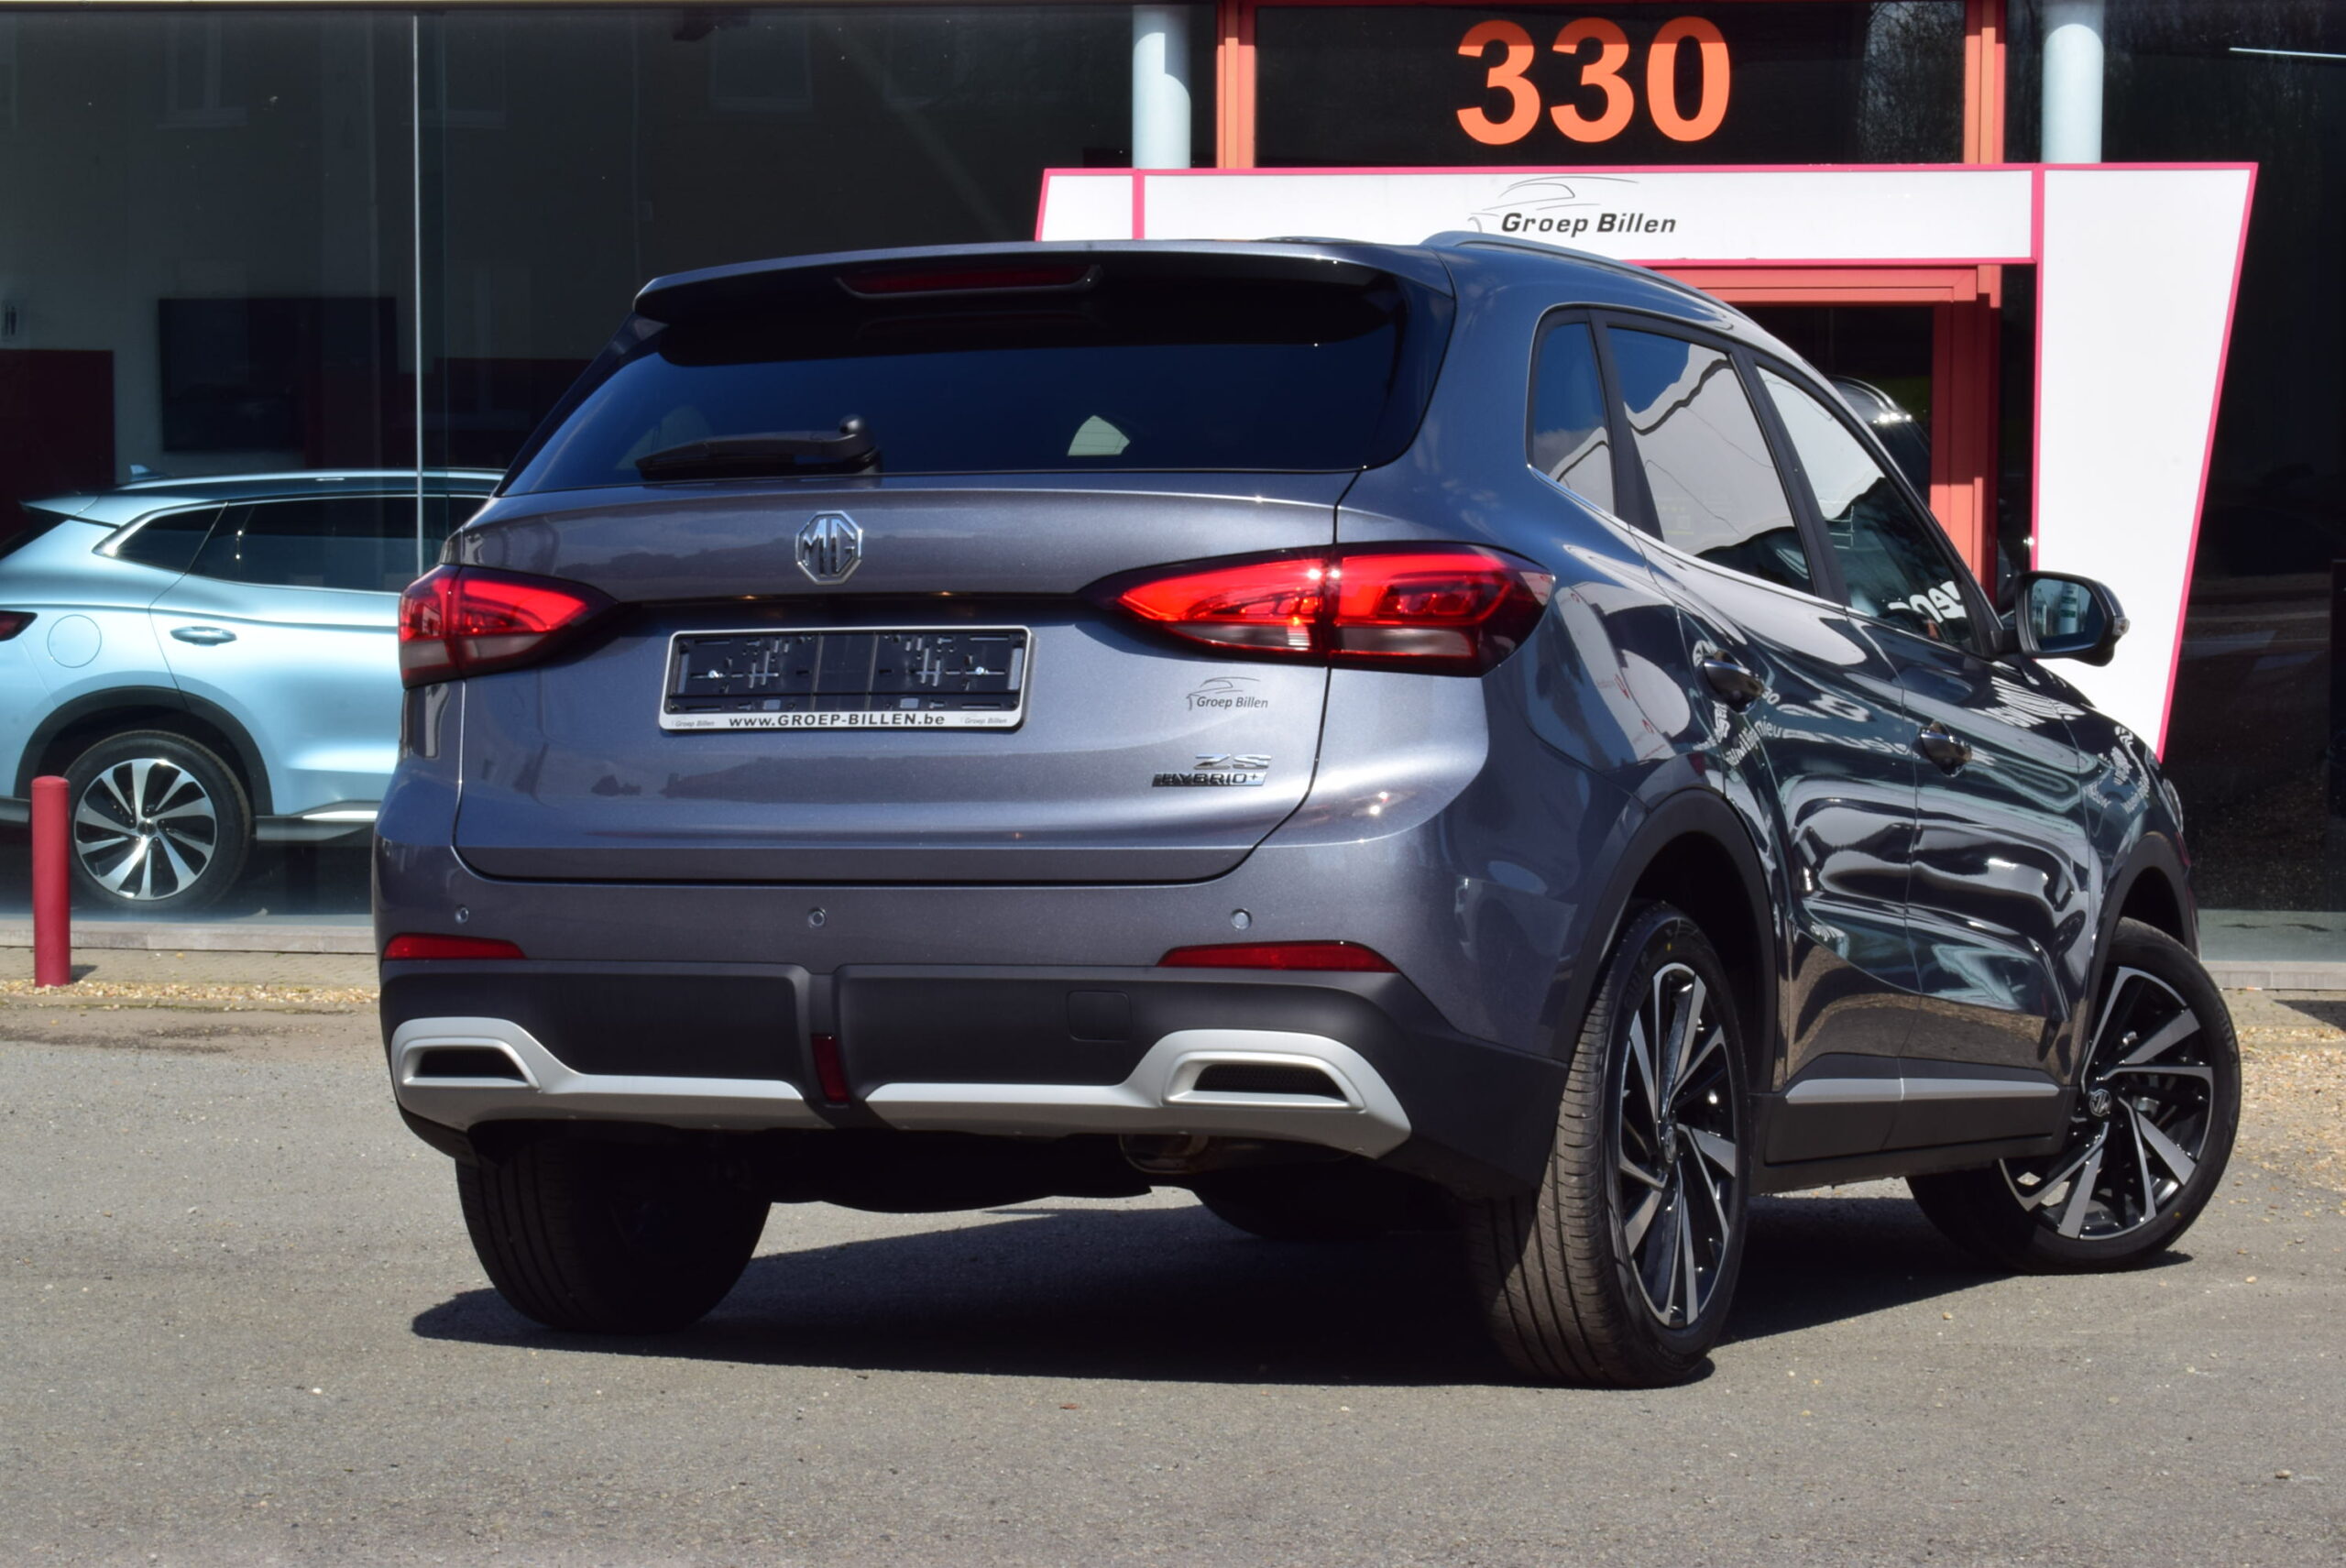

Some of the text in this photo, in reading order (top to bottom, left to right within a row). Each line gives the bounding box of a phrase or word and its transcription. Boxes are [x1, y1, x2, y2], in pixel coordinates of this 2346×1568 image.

[1456, 16, 1730, 145] 330
[1501, 212, 1676, 237] Groep Billen
[801, 516, 858, 578] MG
[1196, 696, 1269, 709] Groep Billen
[729, 713, 945, 727] www.GROEP-BILLEN.be
[1193, 753, 1271, 770] ZS
